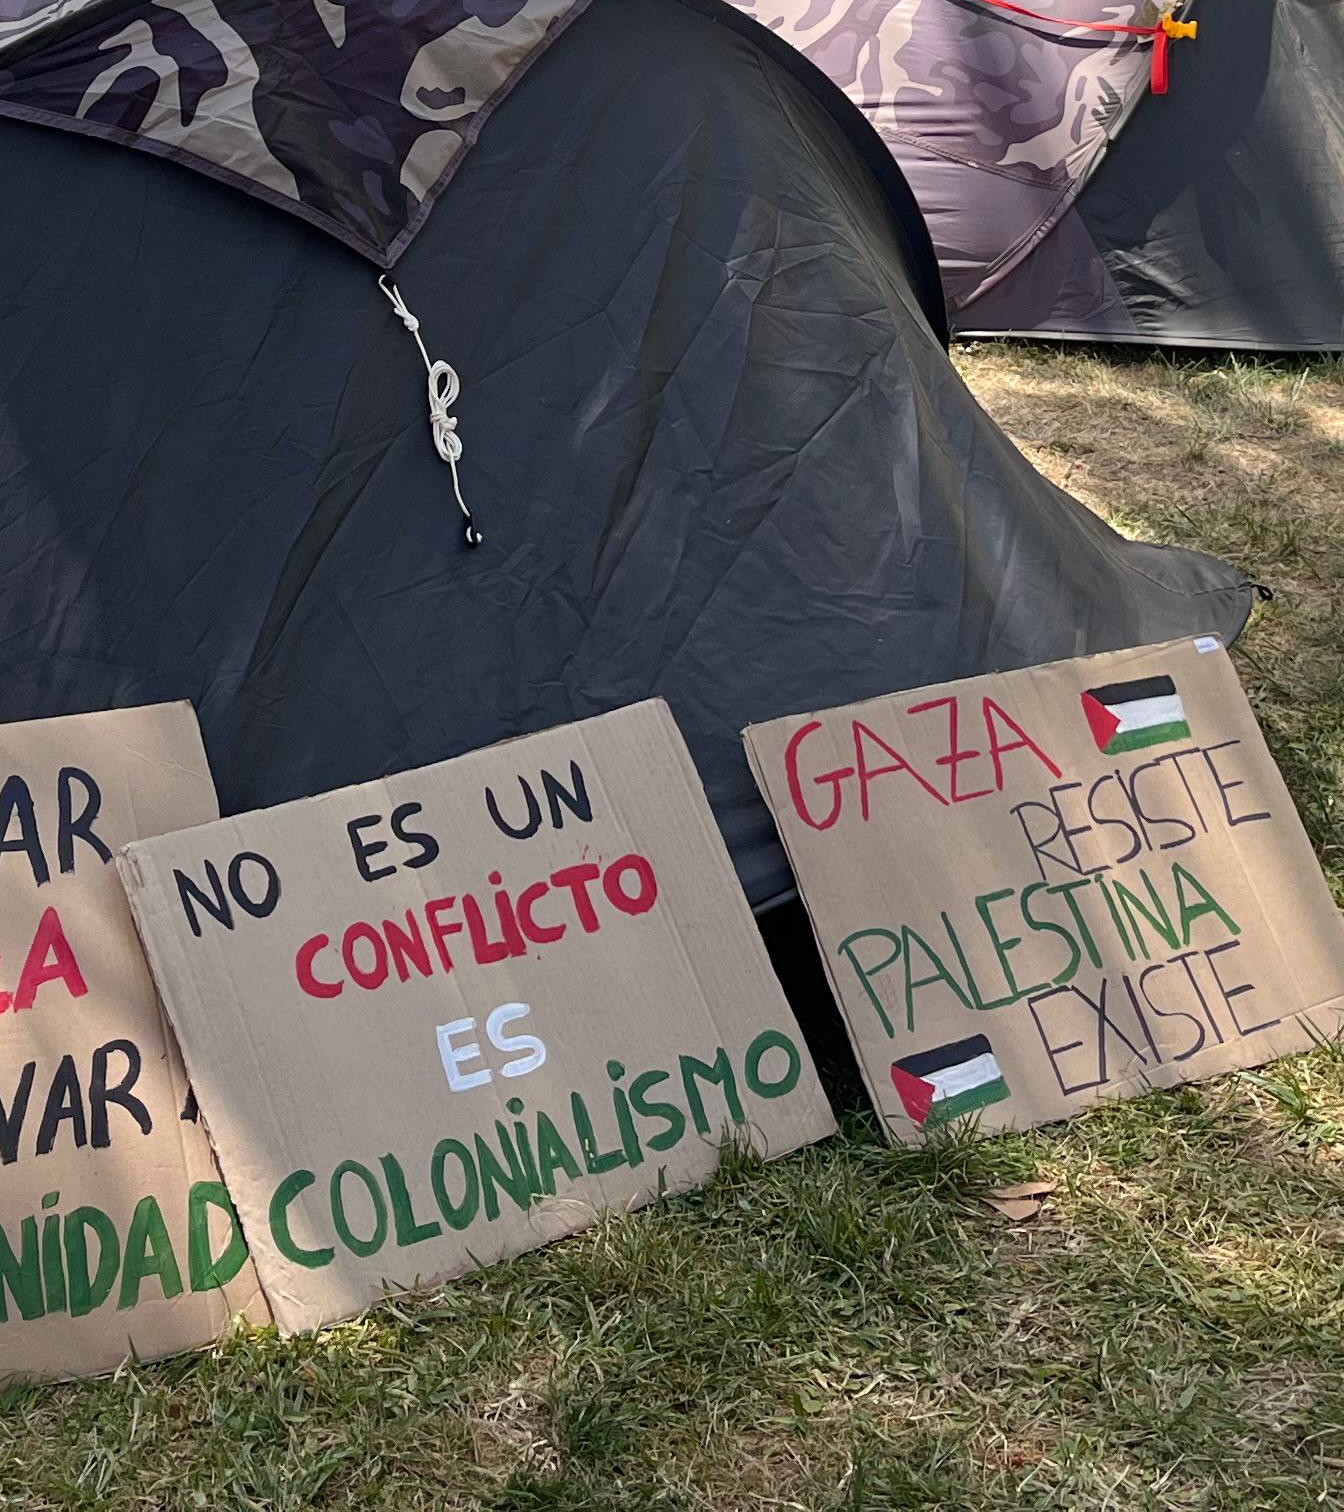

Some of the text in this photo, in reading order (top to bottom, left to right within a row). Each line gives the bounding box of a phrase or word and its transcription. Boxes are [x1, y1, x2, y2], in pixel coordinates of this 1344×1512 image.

[784, 696, 1063, 830] GAZA
[173, 760, 594, 938] NO ES UN
[435, 1002, 547, 1092] ES
[1028, 939, 1282, 1096] EXISTE
